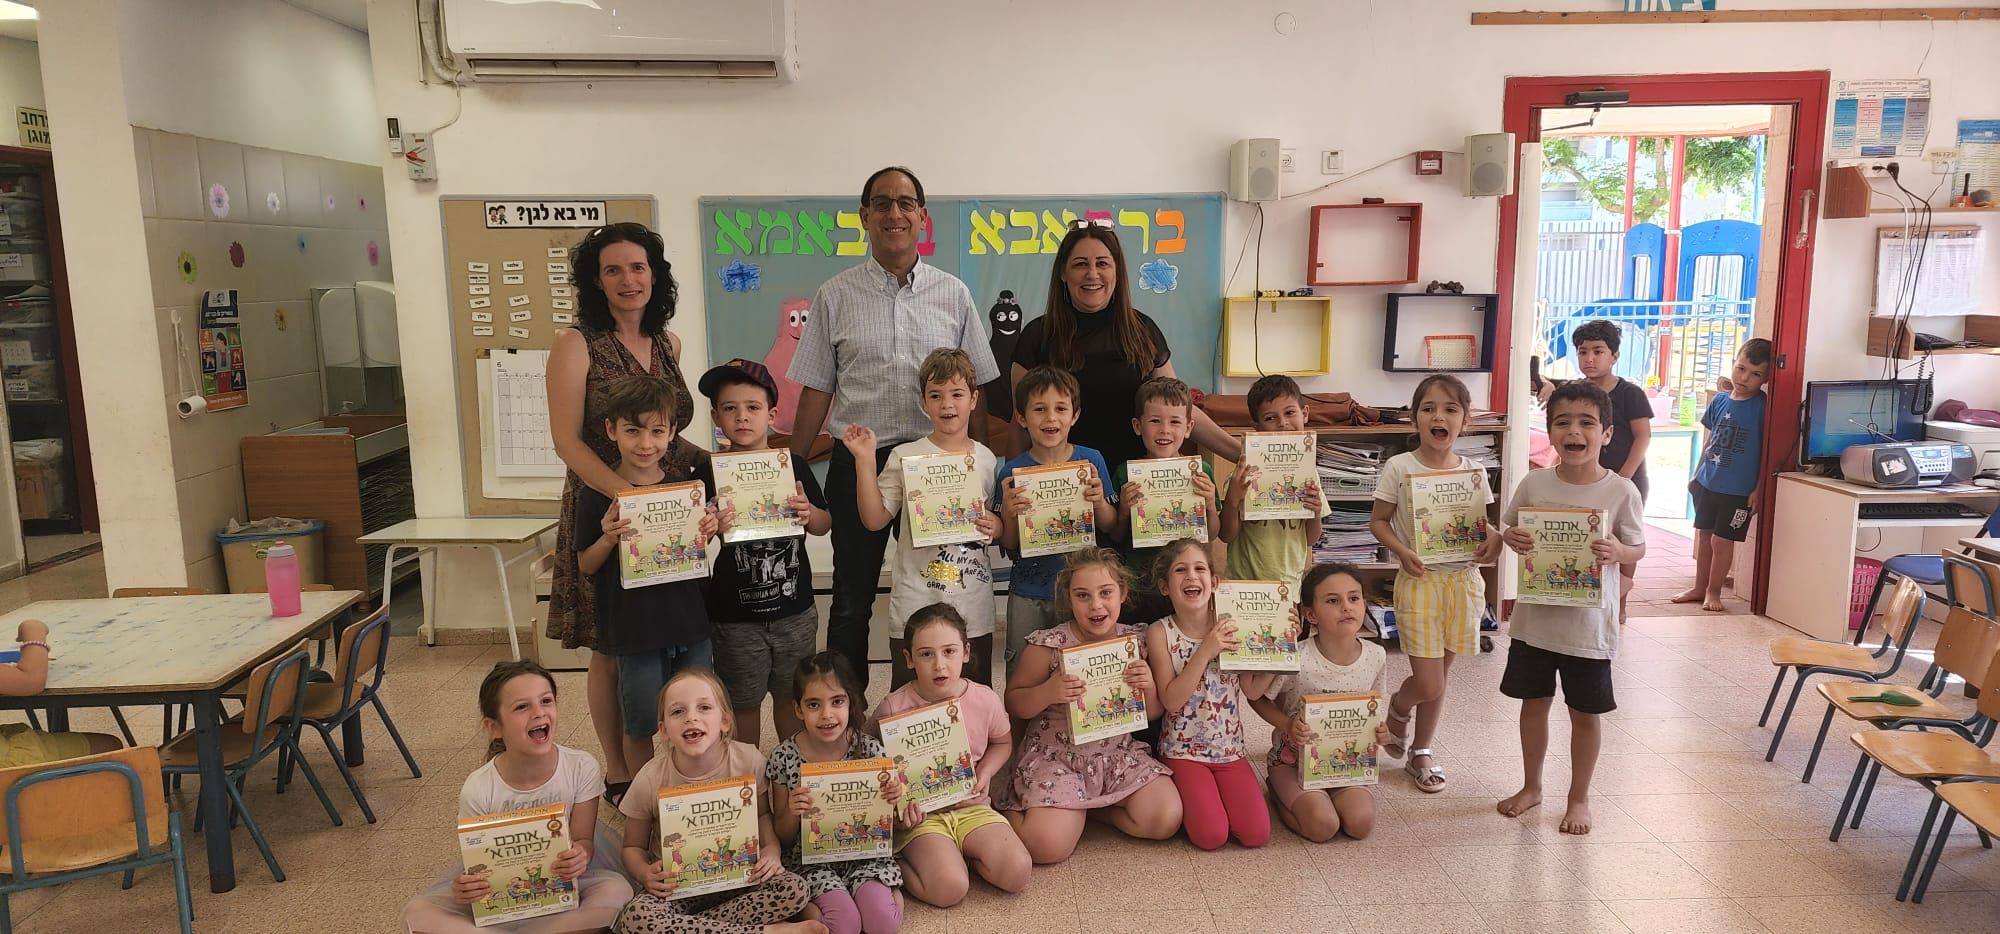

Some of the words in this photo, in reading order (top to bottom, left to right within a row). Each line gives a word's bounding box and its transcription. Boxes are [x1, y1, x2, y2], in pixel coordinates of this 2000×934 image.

[516, 204, 549, 224] לגן?
[554, 206, 576, 220] בא
[580, 206, 598, 220] מי
[1268, 443, 1297, 452] אתכם
[1274, 450, 1304, 462] לכיתה
[738, 460, 771, 471] אתכם
[927, 464, 958, 474] אתכם
[746, 467, 780, 480] לכיתה
[935, 470, 967, 484] לכיתה
[1151, 468, 1182, 478] אתכם
[1039, 477, 1070, 489] אתכם
[1158, 475, 1190, 488] לכיתה
[1435, 482, 1465, 492] אתכם
[1046, 484, 1078, 498] לכיתה
[1442, 488, 1473, 502] לכיתה
[647, 499, 682, 512] אתכם
[656, 506, 691, 522] לכיתה
[1736, 512, 1745, 520] 68
[1544, 521, 1579, 531] אתכם
[1552, 530, 1588, 543] לכיתה
[938, 550, 954, 562] ALL
[957, 556, 968, 564] MY
[964, 568, 977, 576] ARE
[1239, 591, 1271, 600] אתכם
[1246, 600, 1280, 611] לכיתה
[1088, 652, 1119, 667] אתכם
[1096, 658, 1128, 676] לכיתה
[1329, 708, 1361, 719] אתכם
[907, 717, 941, 736] אתכם
[1334, 715, 1367, 729] לכיתה
[917, 724, 951, 745] לכיתה
[831, 780, 869, 792] אתכם
[838, 787, 878, 802] לכיתה
[691, 798, 732, 814] אתכם
[700, 806, 742, 826] לכיתה
[494, 830, 540, 846] אתכם
[505, 837, 550, 856] לכיתה
